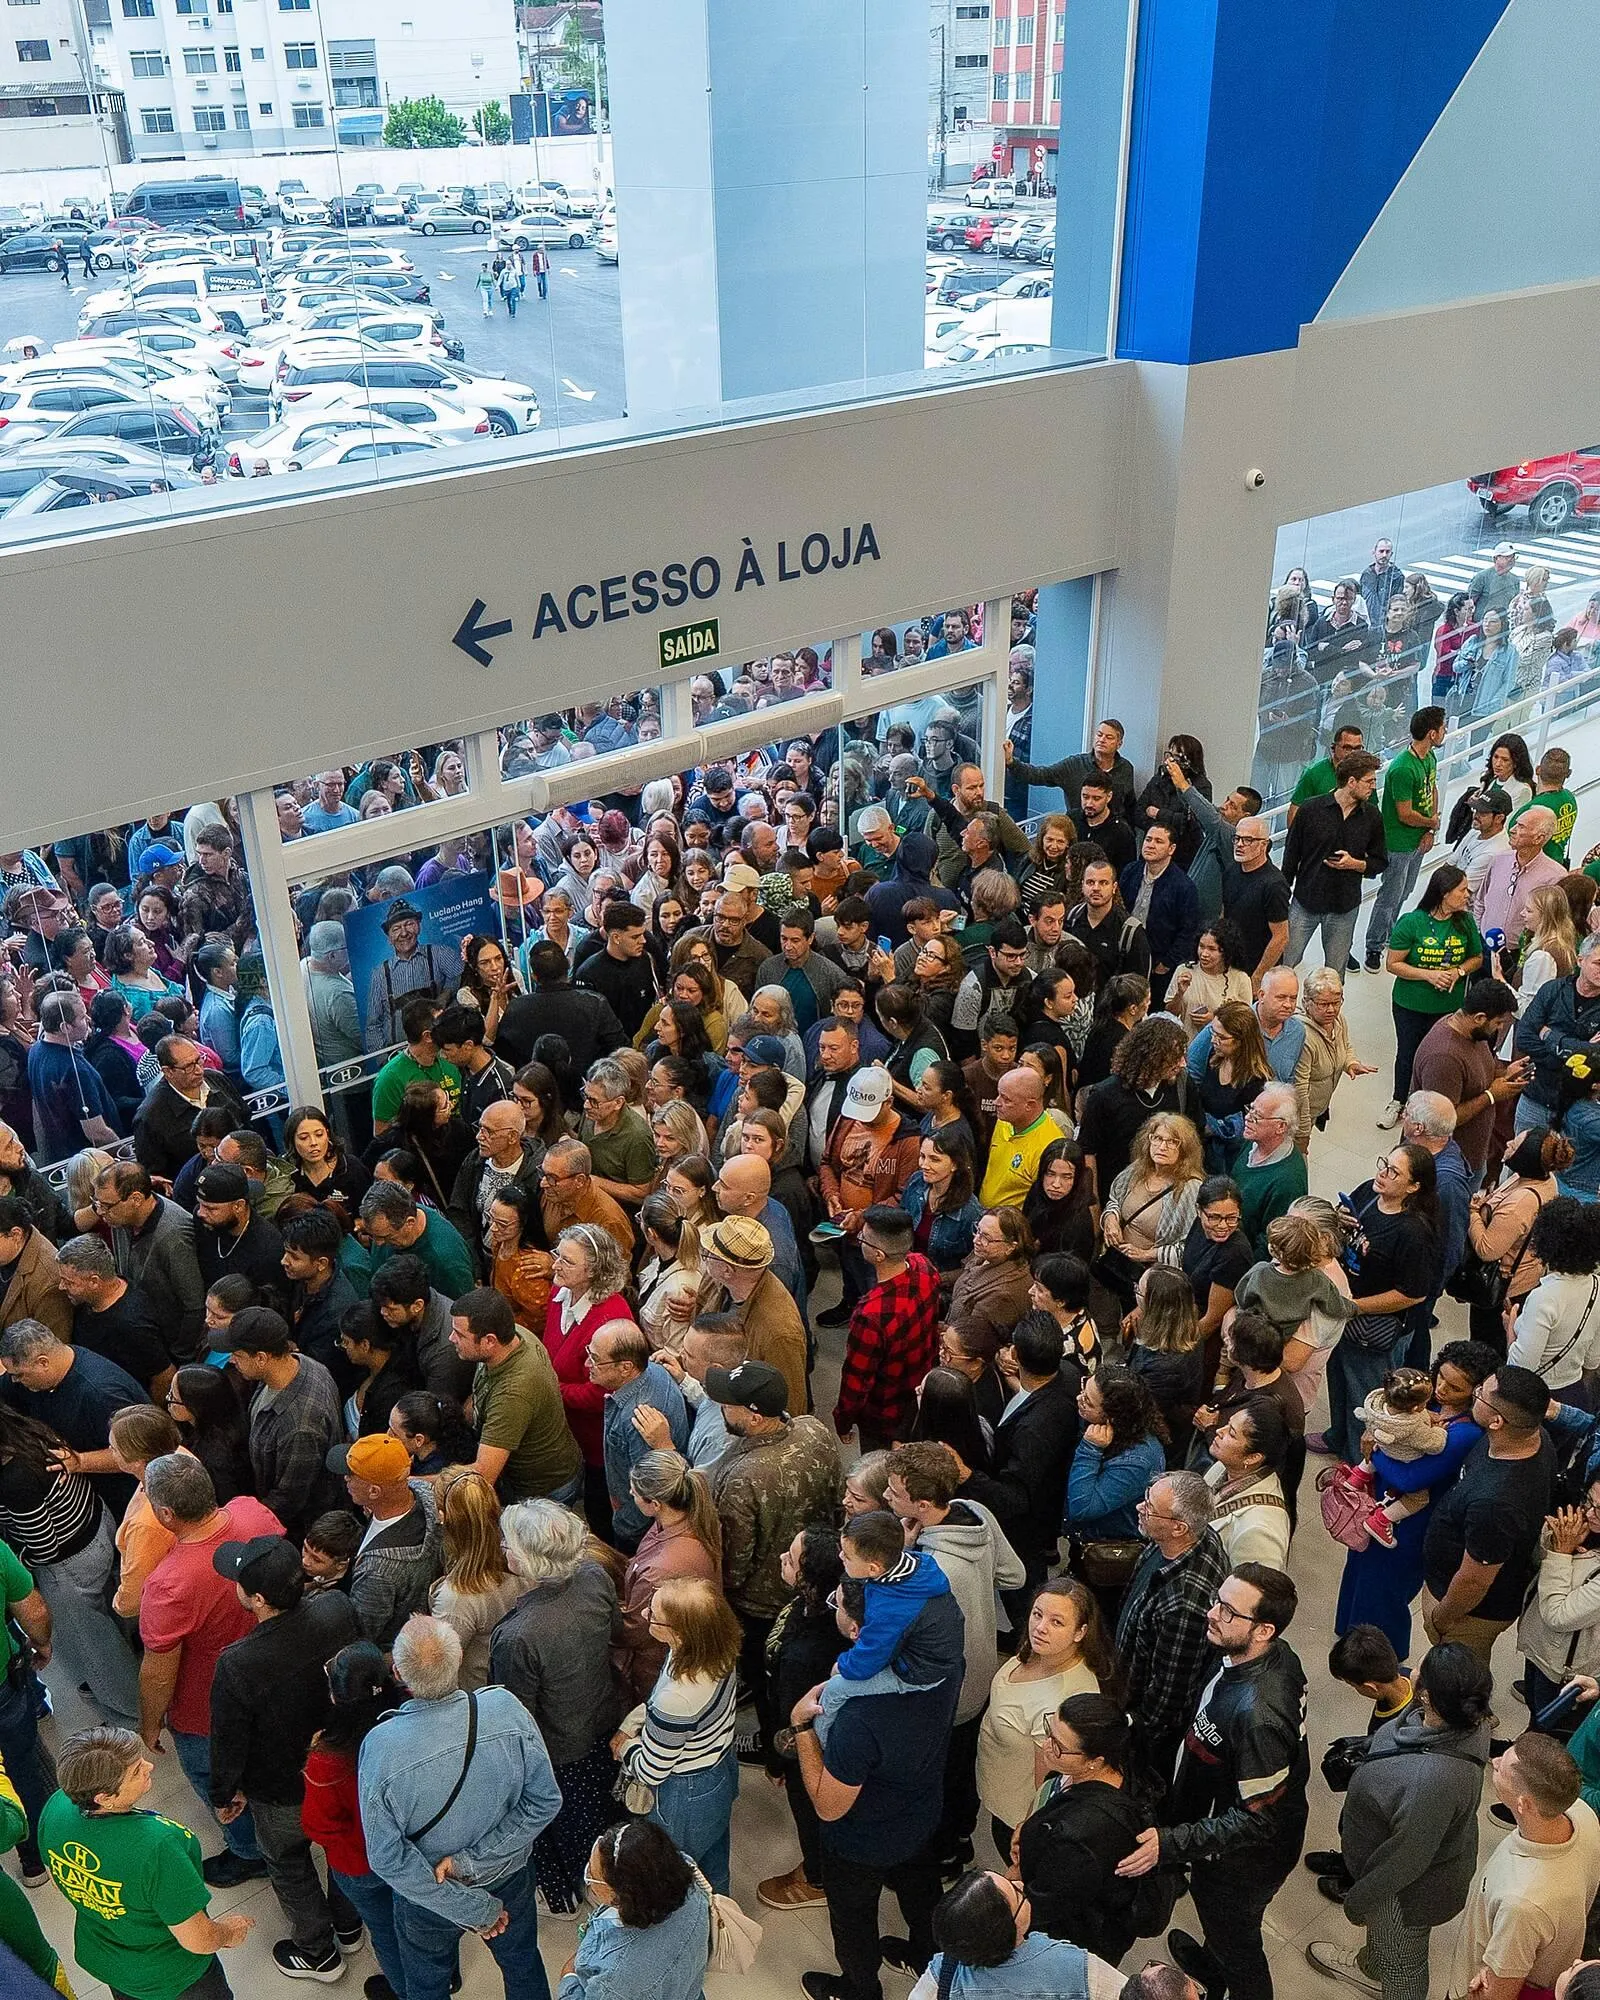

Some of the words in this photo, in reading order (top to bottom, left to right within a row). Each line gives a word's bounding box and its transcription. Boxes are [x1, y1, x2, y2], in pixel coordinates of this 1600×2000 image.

[532, 556, 721, 639] ACESSO
[734, 537, 766, 592] À
[777, 523, 881, 582] LOJA
[663, 628, 716, 661] SAÍDA
[429, 904, 461, 920] Luciano
[462, 897, 483, 909] Hang
[340, 1069, 353, 1082] H
[256, 1097, 269, 1110] H
[75, 1846, 88, 1869] H
[50, 1855, 121, 1905] HAVAN
